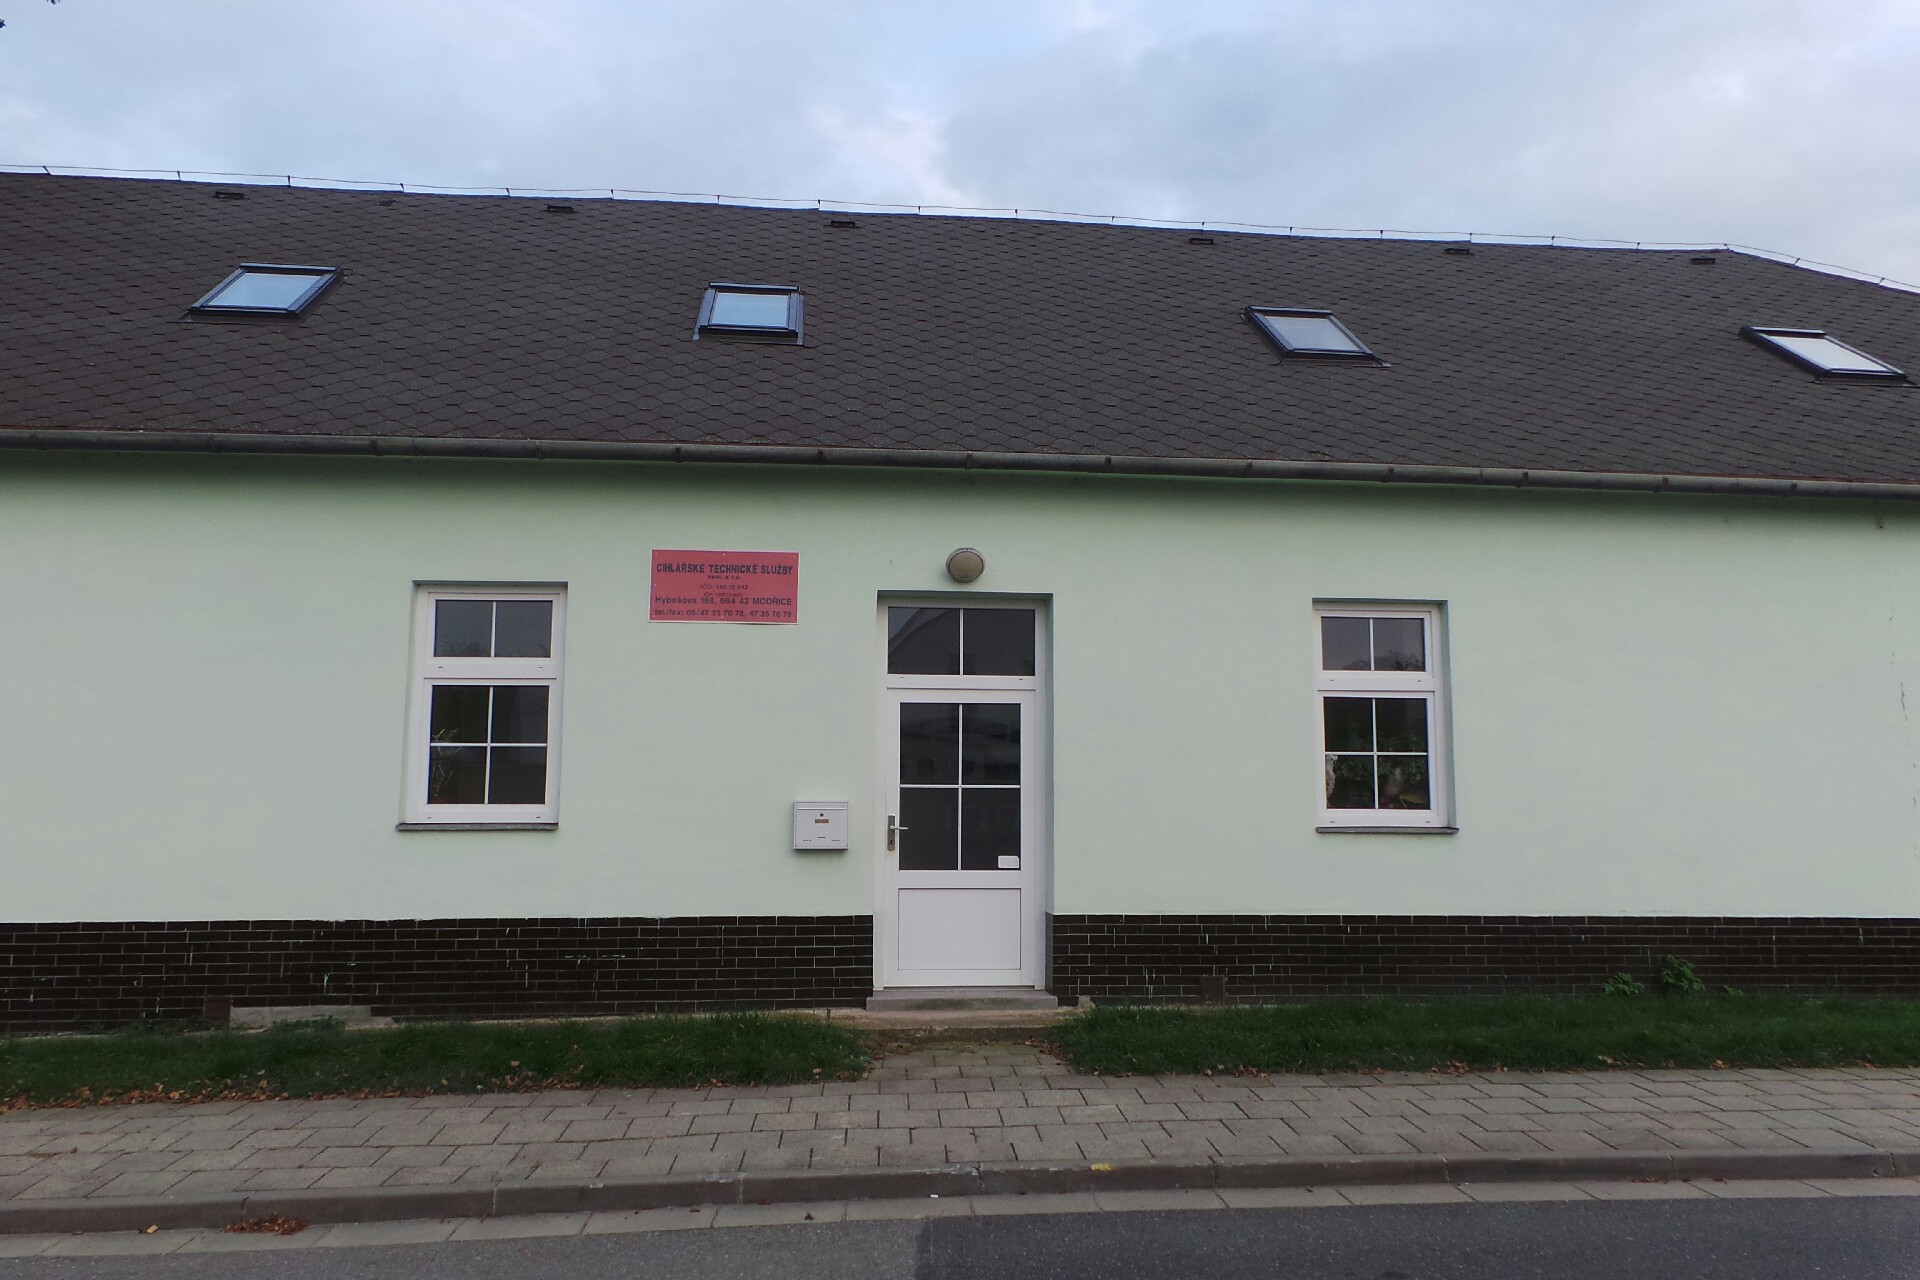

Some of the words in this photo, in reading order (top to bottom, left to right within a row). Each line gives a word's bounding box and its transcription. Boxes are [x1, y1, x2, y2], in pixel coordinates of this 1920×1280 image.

[709, 562, 758, 574] TECHNICKÉ
[761, 563, 793, 575] SLUŽBY
[655, 596, 697, 605] Hybešova
[720, 597, 735, 605] 664
[752, 596, 792, 606] MODŘICE
